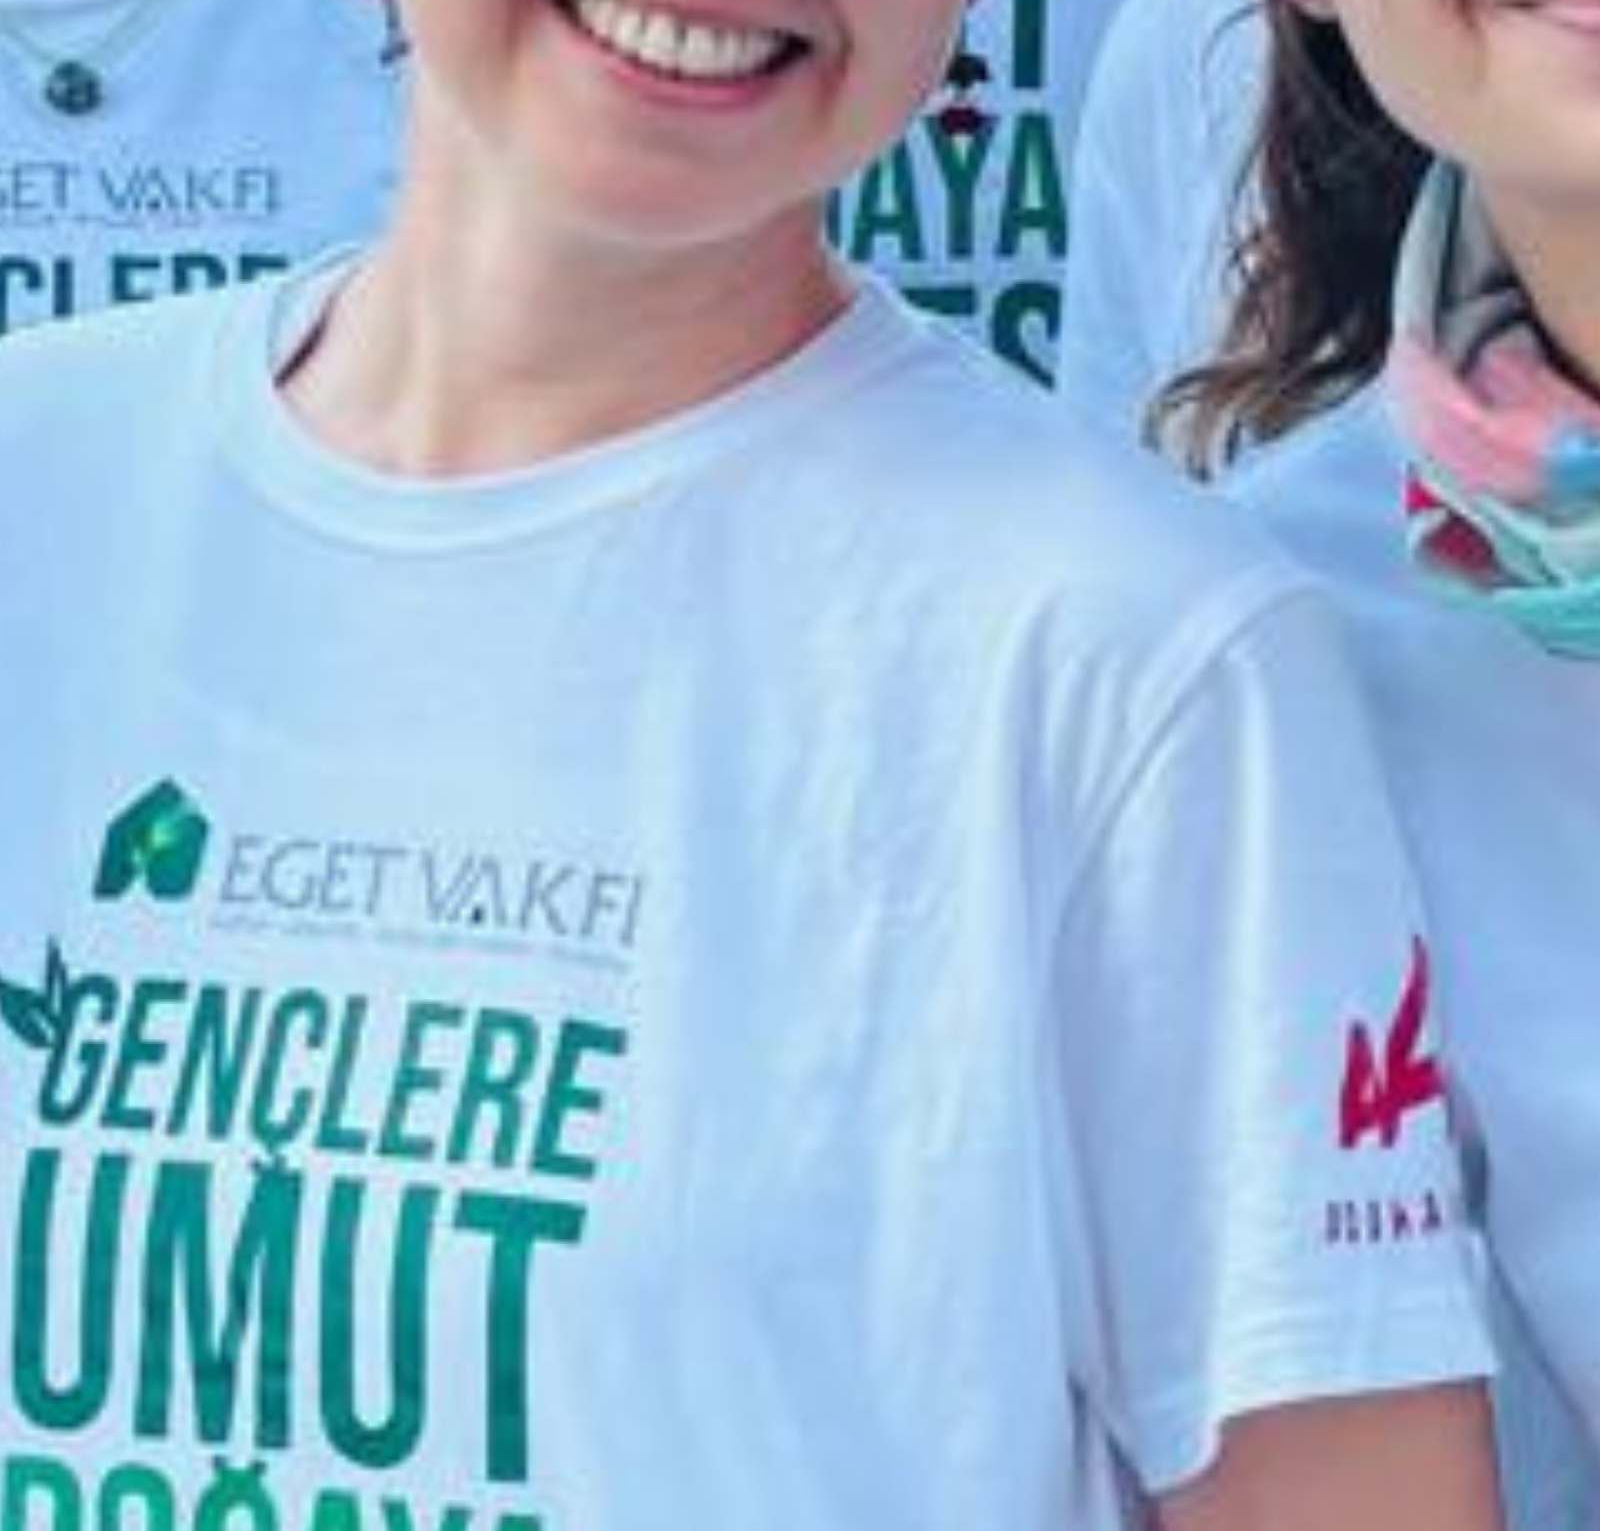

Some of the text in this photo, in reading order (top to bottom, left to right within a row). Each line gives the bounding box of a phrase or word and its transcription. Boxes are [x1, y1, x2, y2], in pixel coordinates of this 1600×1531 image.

[96, 163, 282, 214] VAKFI
[826, 109, 1068, 263] AYA
[218, 832, 410, 919] EGET
[417, 847, 648, 950] VAKFI
[36, 971, 630, 1181] GENÇLERE
[12, 1146, 586, 1485] UMUT
